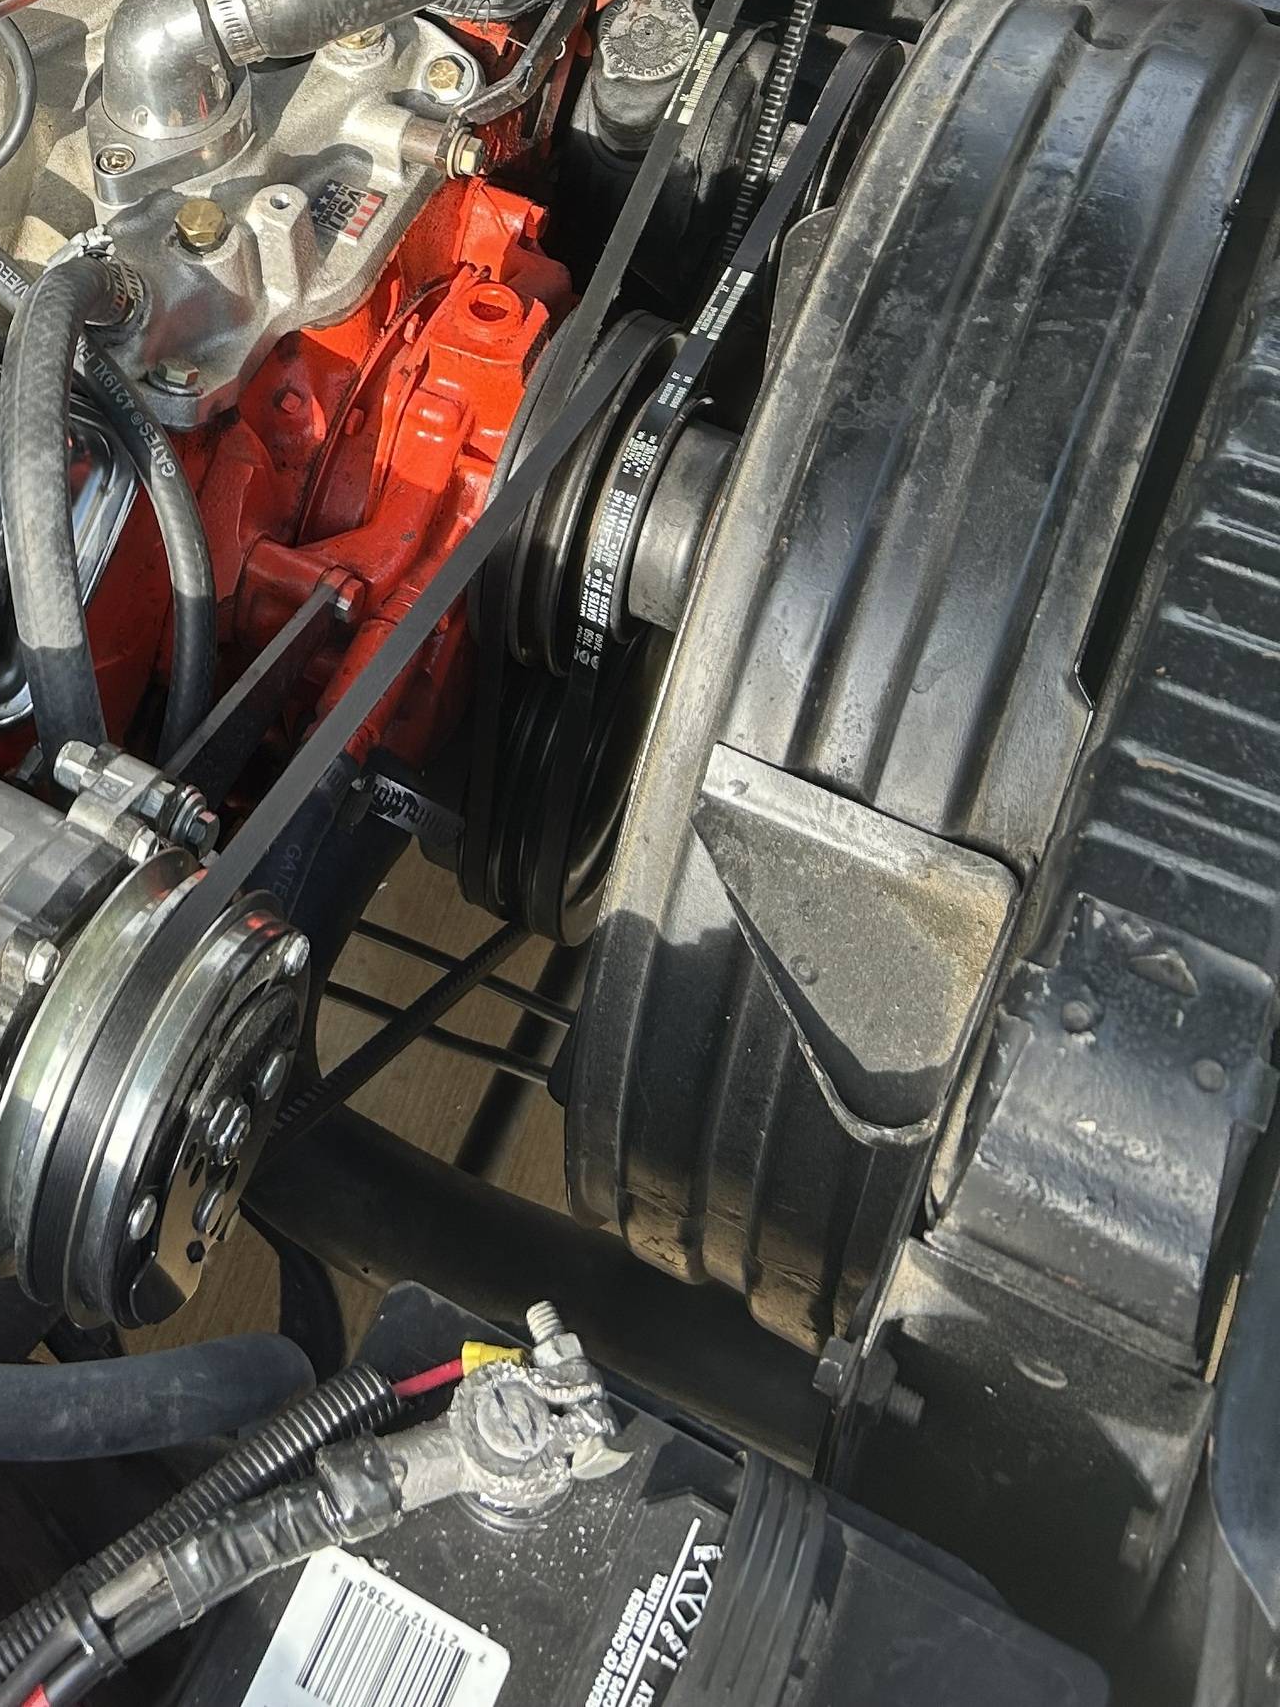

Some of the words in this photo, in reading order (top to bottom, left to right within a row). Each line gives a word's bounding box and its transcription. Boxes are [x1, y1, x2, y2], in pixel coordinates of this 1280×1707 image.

[319, 195, 341, 225] MADE
[337, 184, 349, 196] IN
[329, 192, 362, 231] USA
[585, 591, 600, 622] GATES
[358, 1581, 404, 1615] 77386
[411, 1612, 458, 1647] 21112
[602, 1675, 625, 1707] CAPS
[616, 1636, 640, 1677] TIGHT
[633, 1610, 653, 1641] AND
[644, 1573, 668, 1612] LEVEL
[603, 1648, 619, 1671] OF
[612, 1588, 646, 1652] CHILDREN
